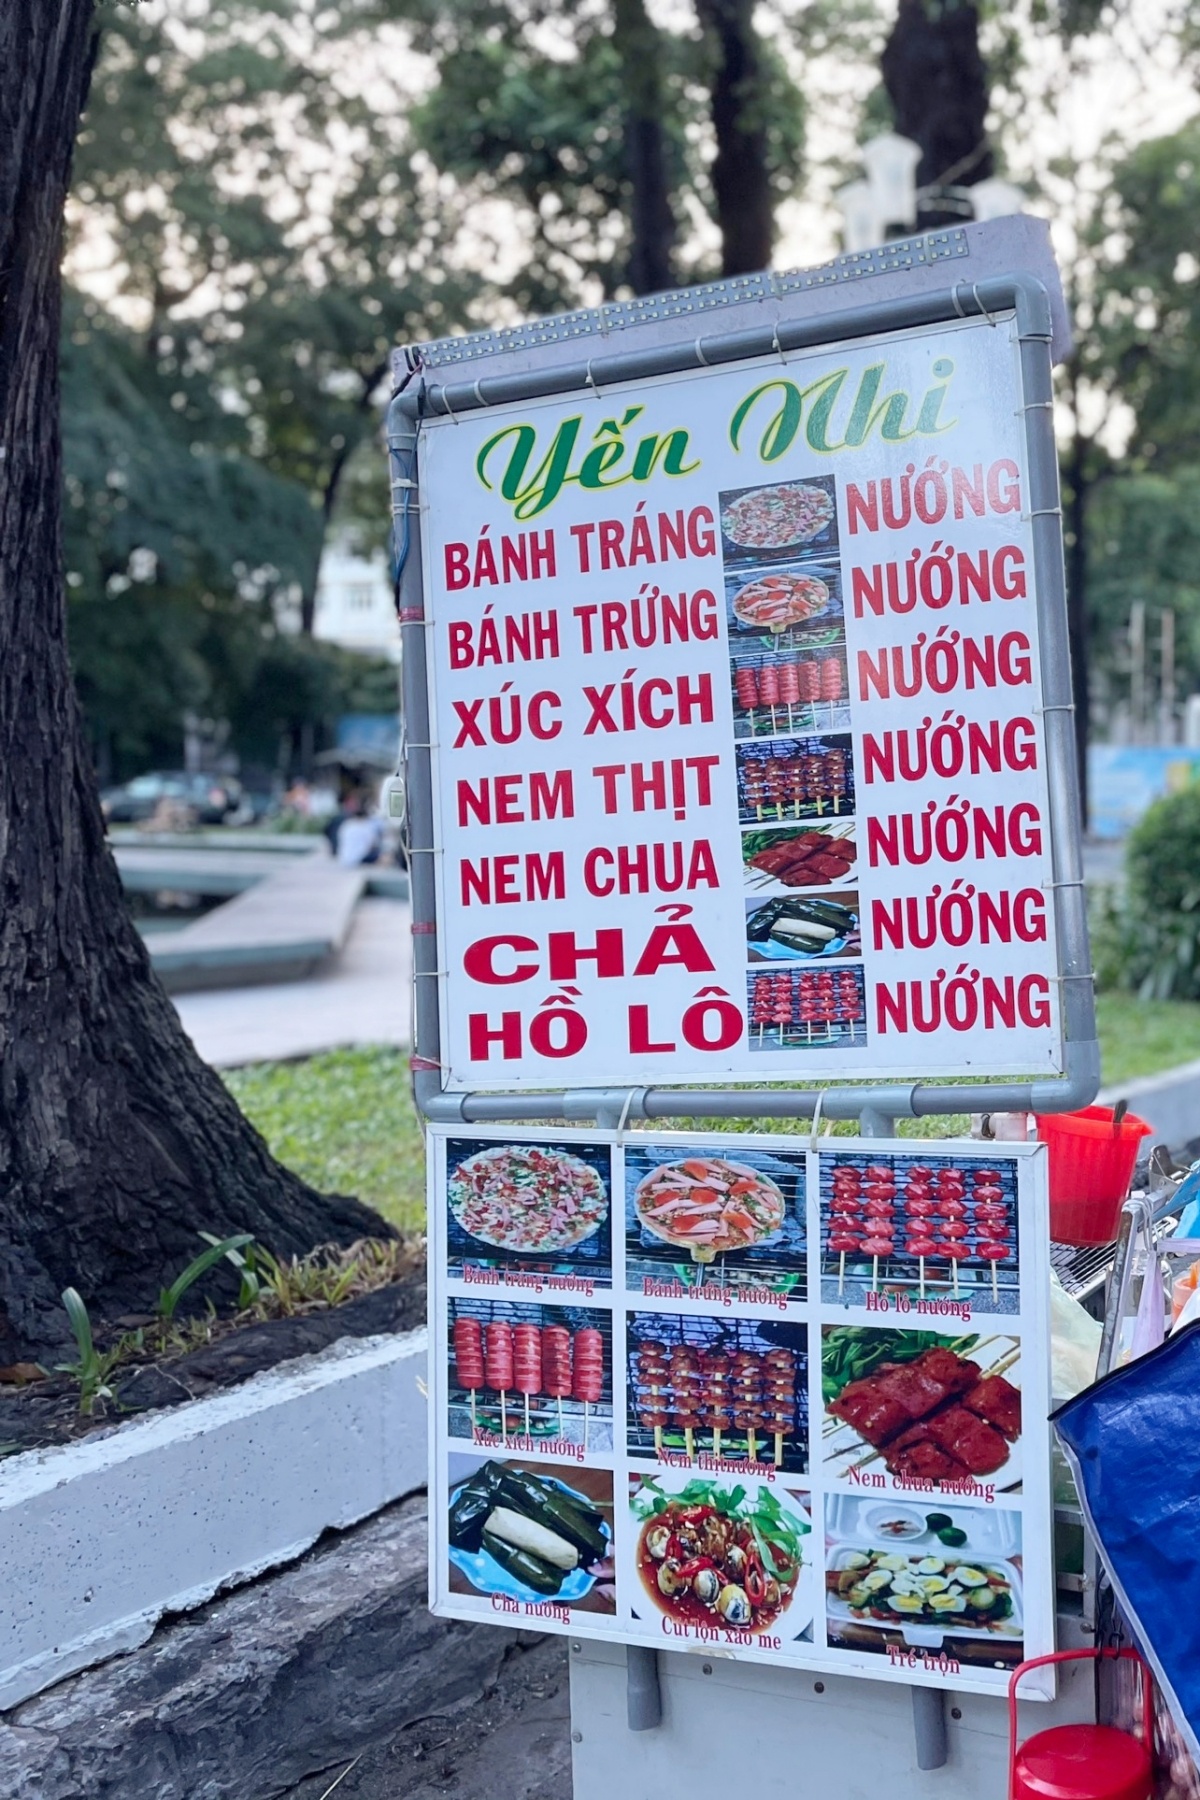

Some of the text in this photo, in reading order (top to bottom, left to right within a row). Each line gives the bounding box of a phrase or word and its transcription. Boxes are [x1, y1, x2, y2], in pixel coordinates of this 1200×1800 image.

[476, 357, 957, 521] Yến Nhi
[445, 457, 1022, 591] BÁNH TRÁNG NƯỚNG
[449, 540, 1028, 670] BÁNH TRỨNG NƯỚNG
[453, 624, 1033, 749] XÚC XÍCH NƯỚNG
[457, 710, 1037, 828] NEM THỊT NƯỚNG
[460, 794, 1043, 907] NEM CHUA NƯỚNG
[463, 878, 1047, 985] CHẢ NƯỚNG
[468, 963, 1051, 1062] HỒ LÔ NƯỚNG
[463, 1263, 596, 1297] Bánh tráng nướng
[643, 1275, 788, 1310] Bánh trứng nướng
[866, 1289, 972, 1322] Hồ lô nướng
[504, 1431, 534, 1452] xích
[540, 1436, 585, 1462] nướng
[657, 1446, 692, 1469] Nem
[848, 1465, 995, 1503] Nem chua nướng
[491, 1591, 571, 1625] Chả nướng
[694, 1618, 720, 1643] lộn
[758, 1634, 782, 1650] me
[886, 1644, 961, 1677] Tré trộn
